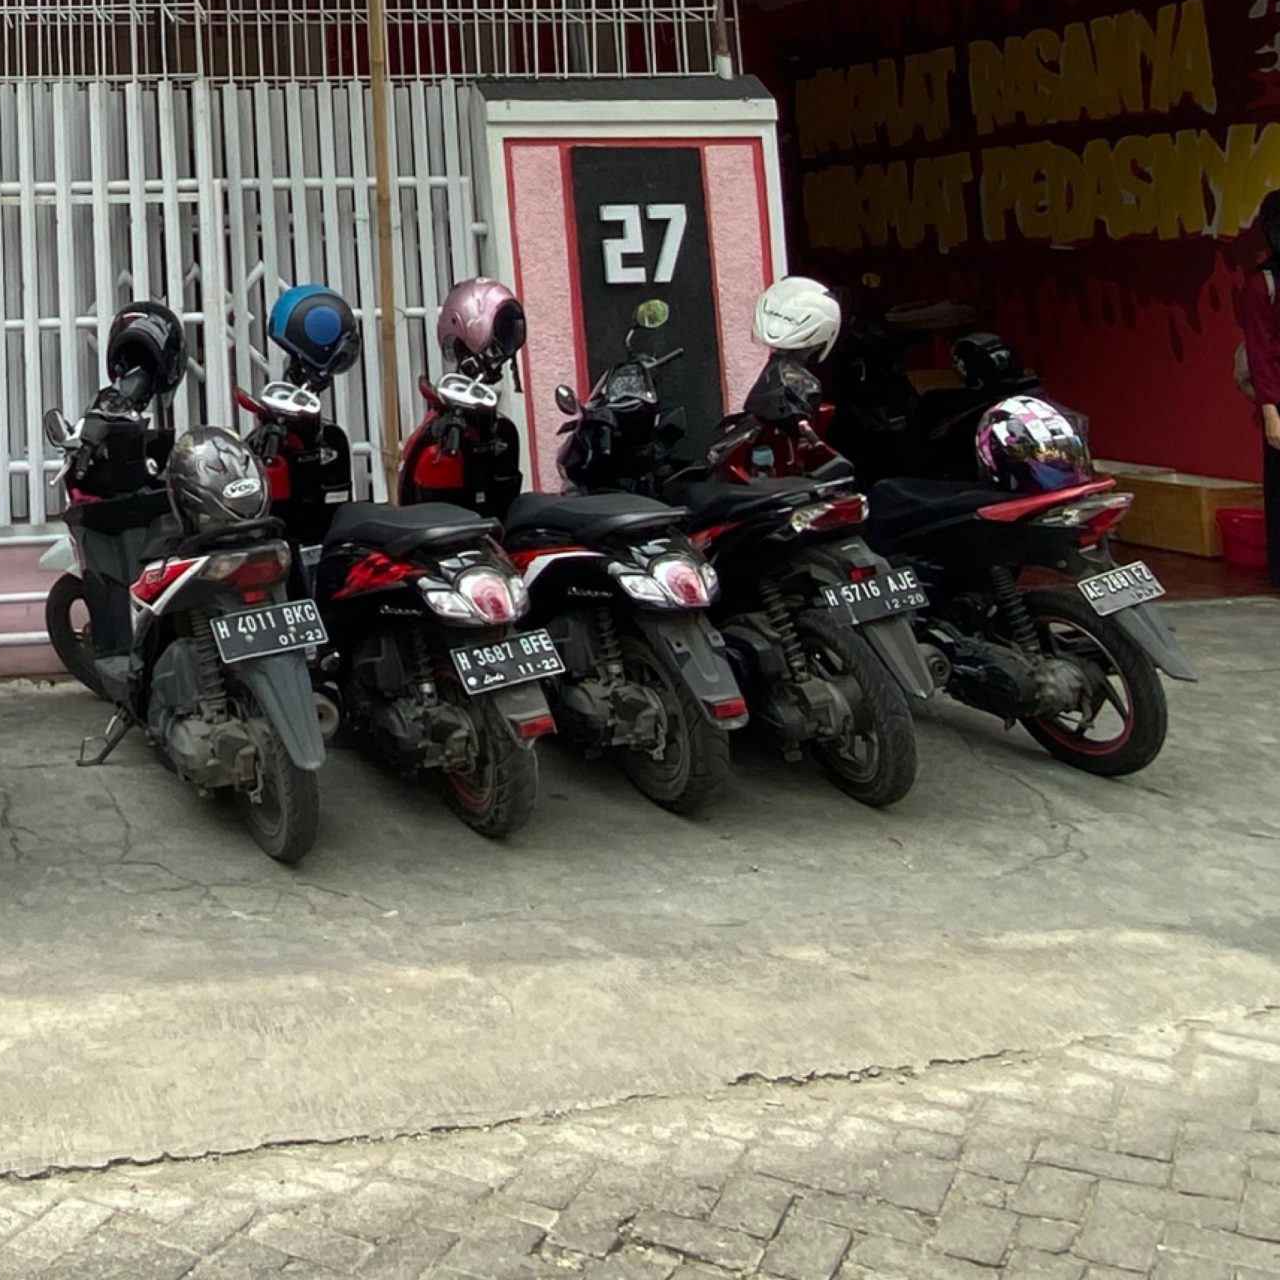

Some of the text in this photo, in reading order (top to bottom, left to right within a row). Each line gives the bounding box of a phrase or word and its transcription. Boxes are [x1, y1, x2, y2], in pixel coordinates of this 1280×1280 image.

[599, 203, 687, 285] 27
[824, 570, 917, 607] H 5716 AJE
[217, 620, 231, 639] H
[237, 610, 276, 633] 4011
[456, 634, 554, 671] H 3687 BFE
